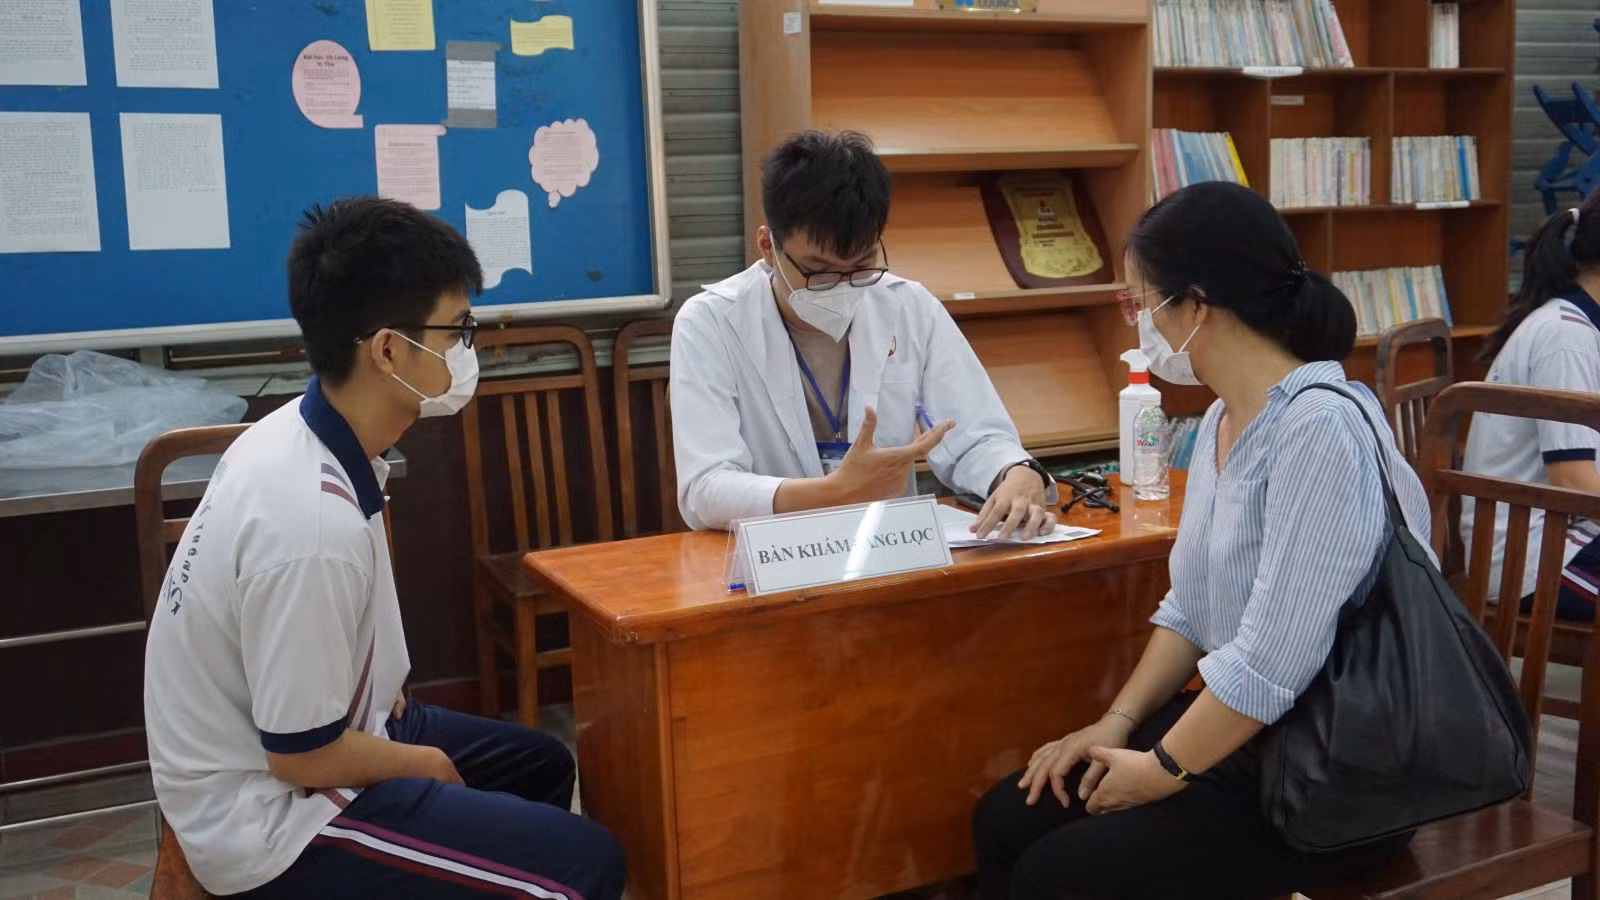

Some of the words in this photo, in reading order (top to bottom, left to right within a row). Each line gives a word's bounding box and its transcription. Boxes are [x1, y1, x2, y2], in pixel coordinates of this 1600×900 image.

[758, 544, 794, 564] BÀN
[797, 537, 850, 559] KHÁM
[900, 527, 934, 545] LỌC
